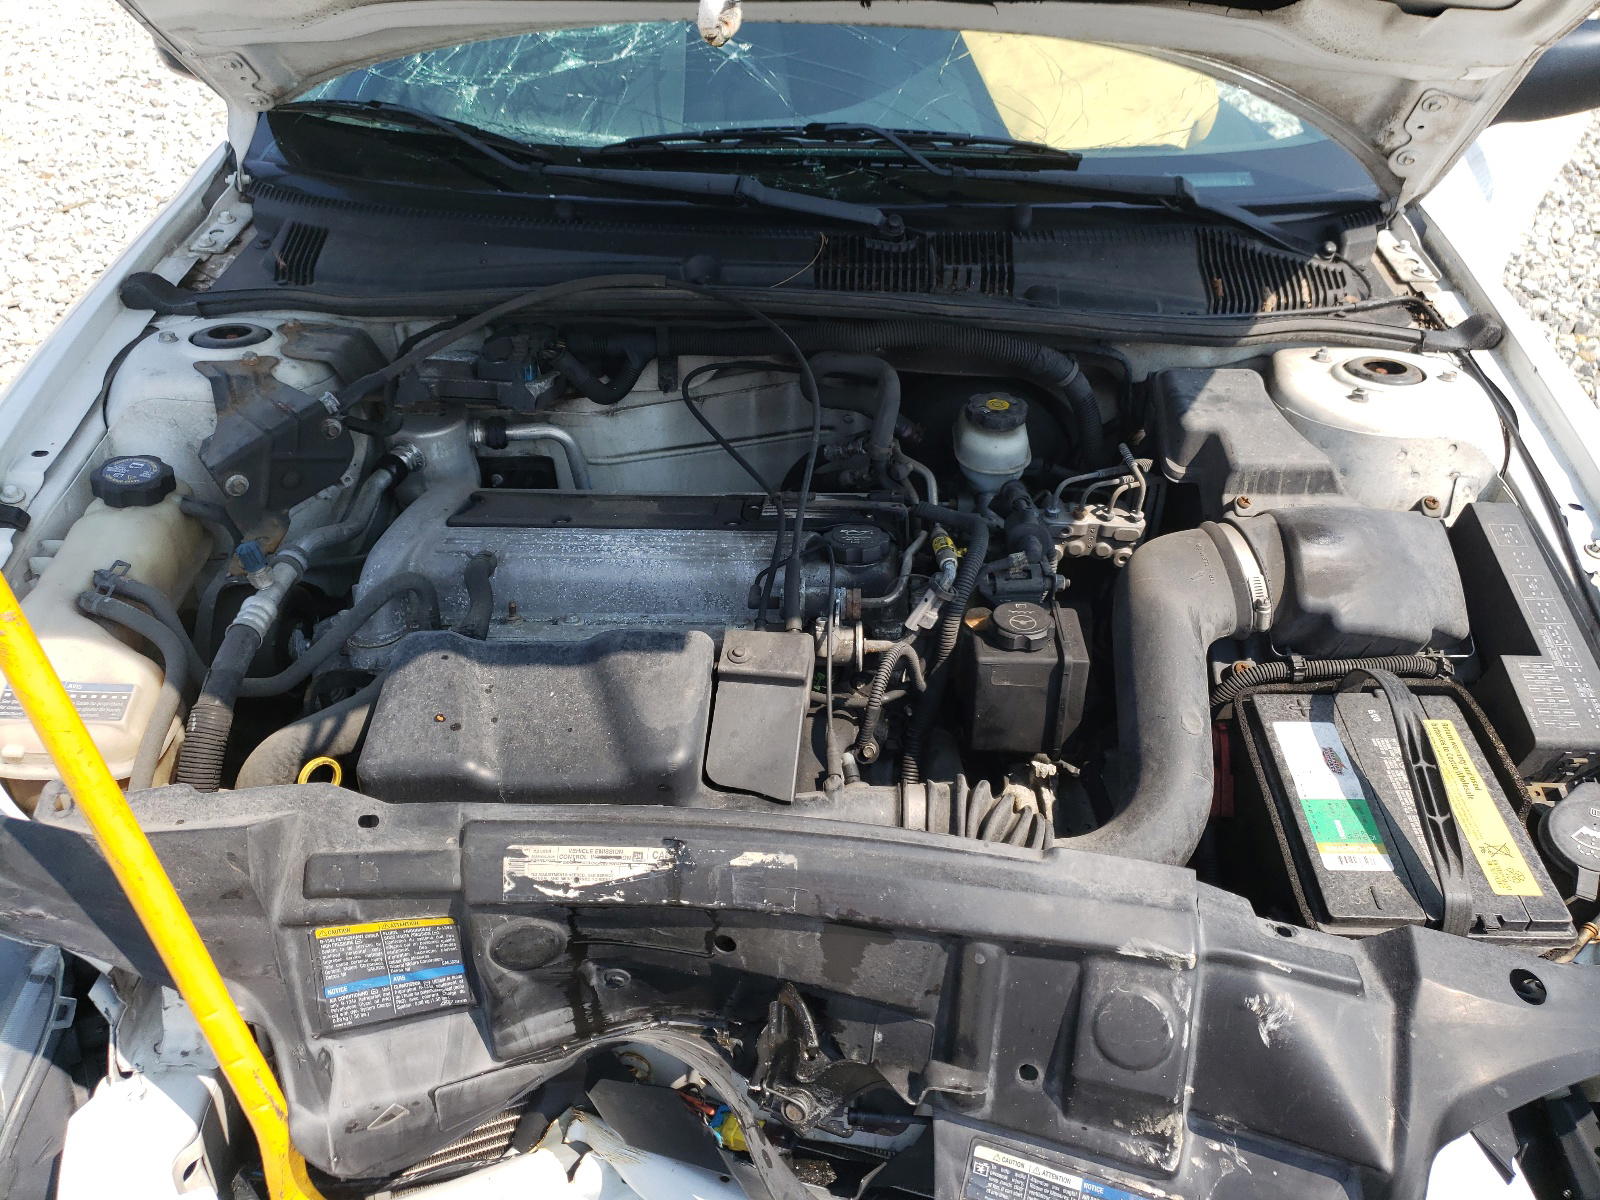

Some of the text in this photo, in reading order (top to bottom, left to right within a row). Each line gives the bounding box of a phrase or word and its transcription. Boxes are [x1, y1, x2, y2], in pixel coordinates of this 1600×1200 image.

[393, 975, 406, 983] AVIS
[327, 985, 348, 996] NOTICE
[1001, 1156, 1025, 1169] CAUTION
[1041, 1169, 1072, 1185] ATTENTION
[1083, 1182, 1105, 1195] NOTICE
